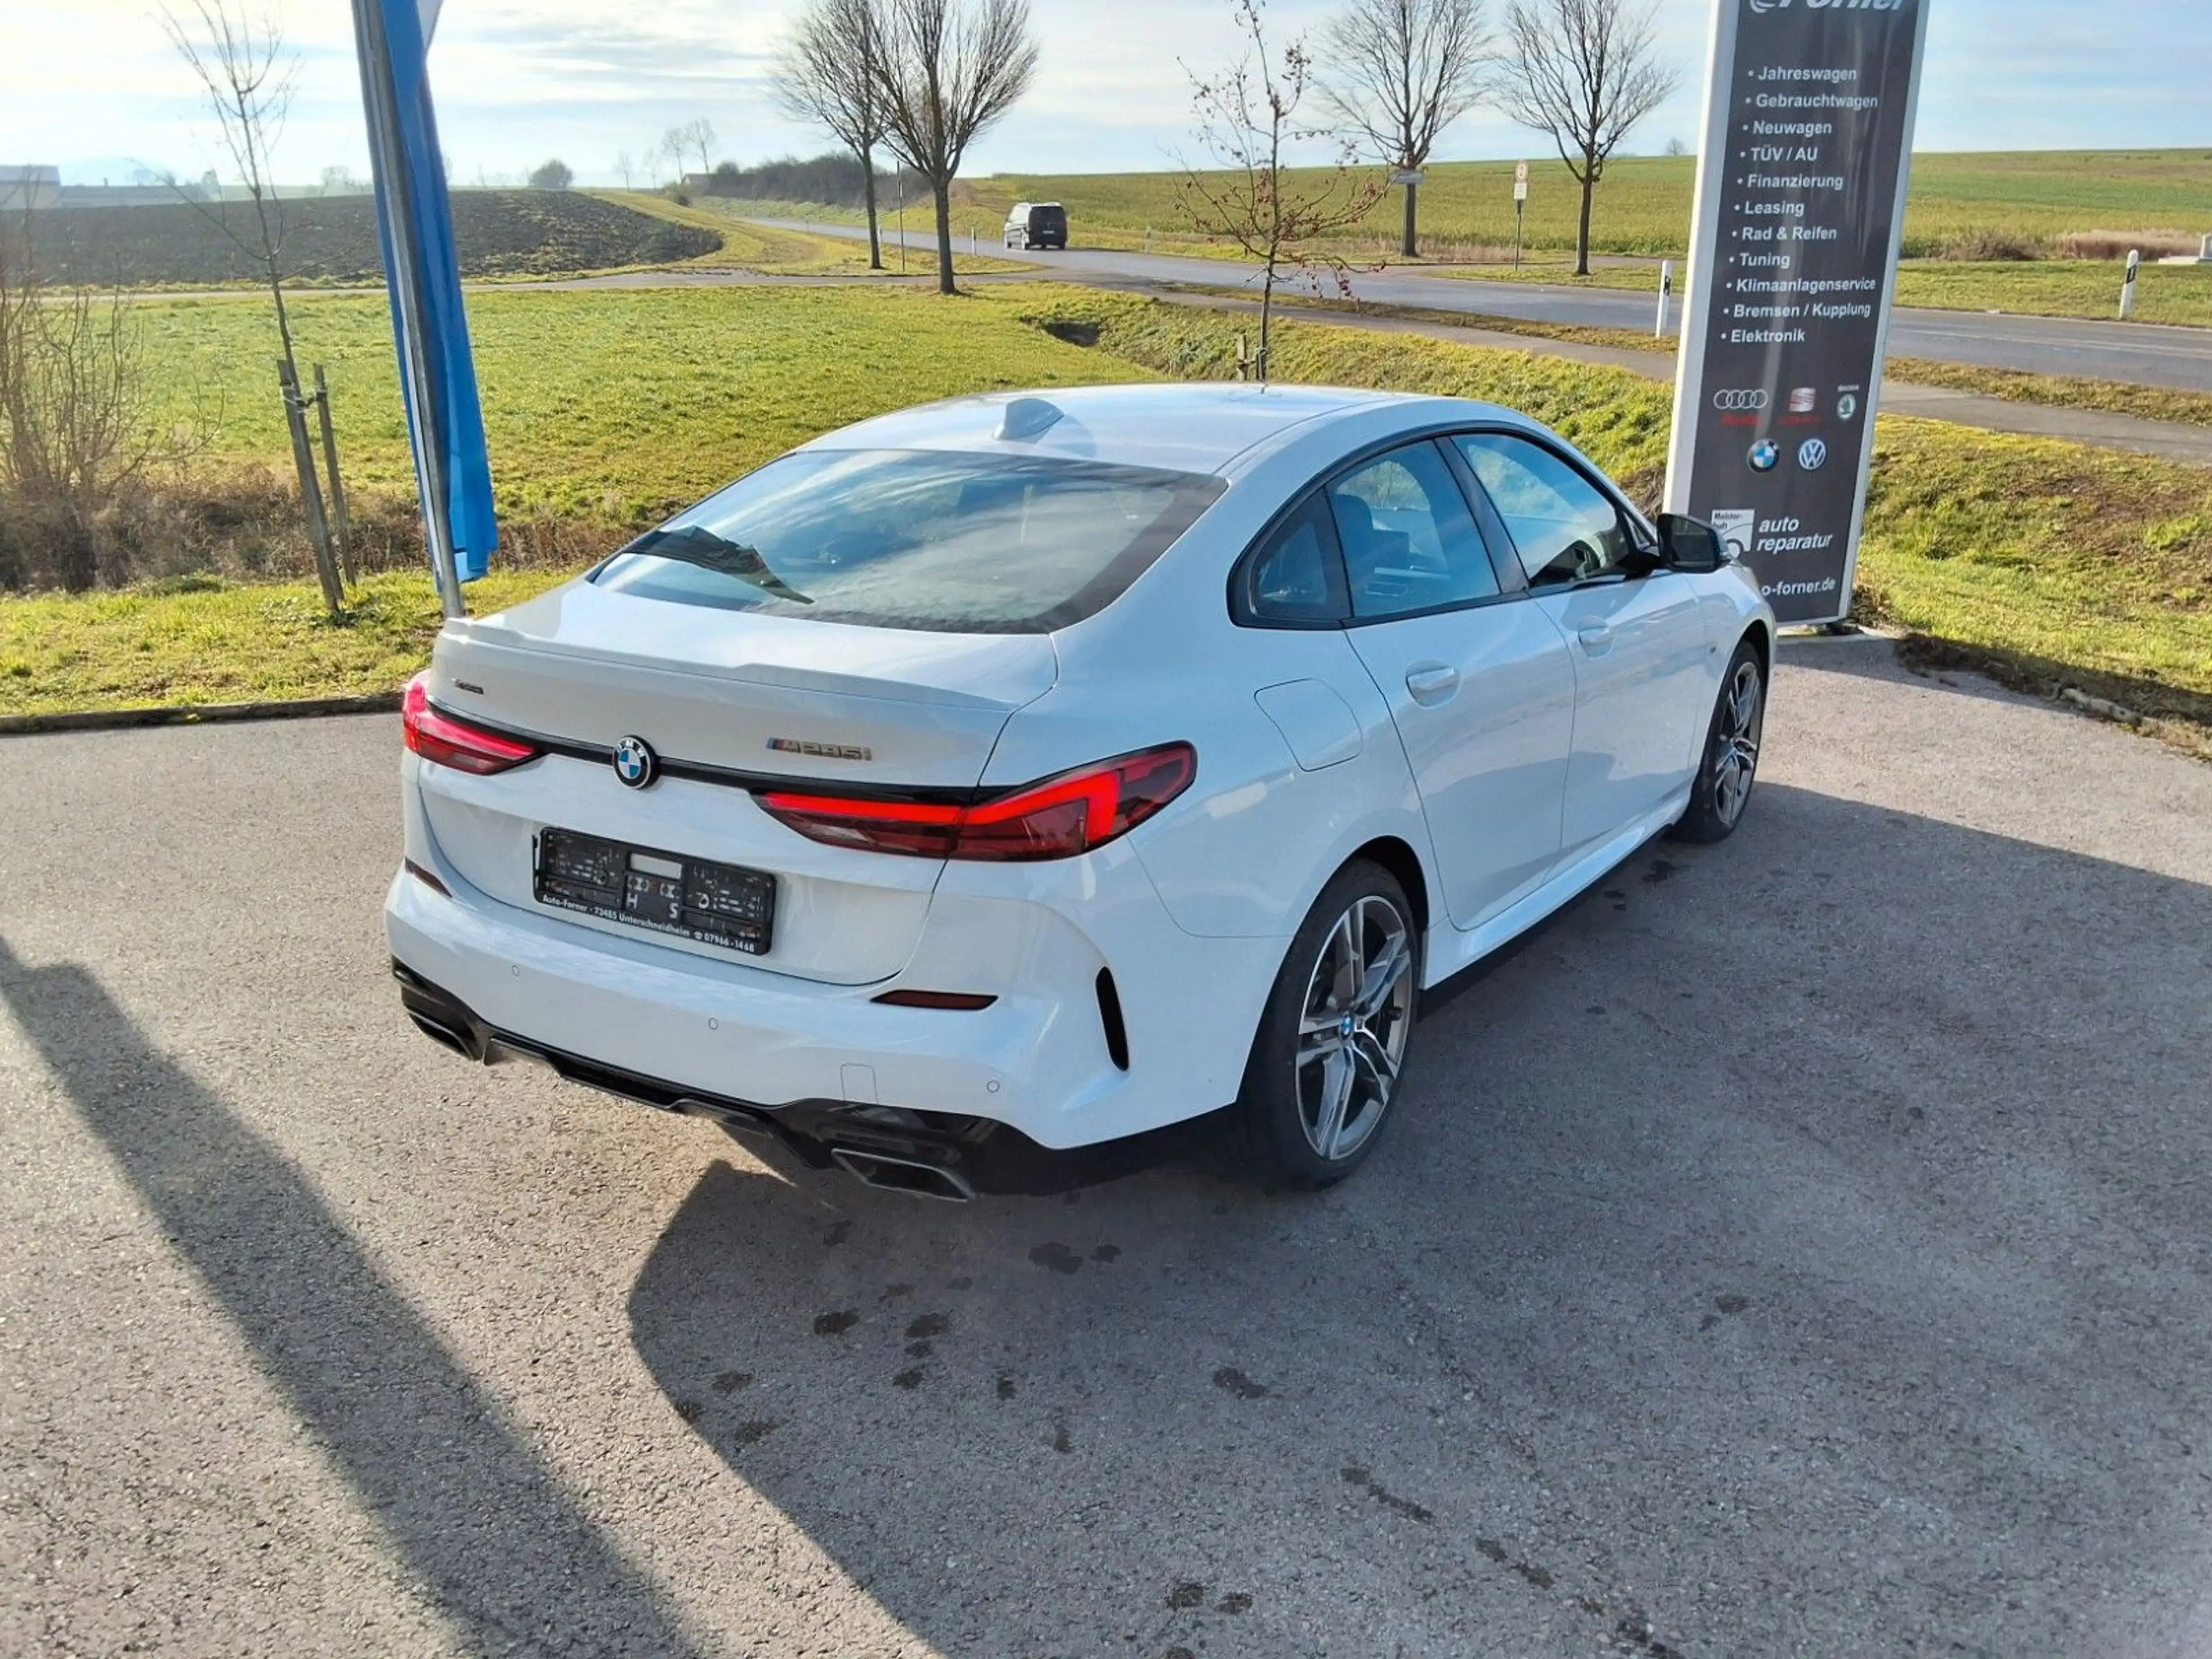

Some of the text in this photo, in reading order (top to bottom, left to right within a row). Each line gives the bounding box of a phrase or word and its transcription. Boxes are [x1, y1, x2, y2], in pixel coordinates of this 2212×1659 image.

[1759, 67, 1857, 82] Jahreswagen
[1756, 93, 1878, 109] Gebrauchtwagen
[1753, 121, 1832, 137] Neuwagen
[1751, 145, 1783, 161] TÜV
[1794, 148, 1818, 161] AU
[1747, 174, 1844, 190] Finanzierung
[1744, 201, 1805, 217] Leasing
[1742, 226, 1837, 241] Rad & Reifen
[1739, 252, 1790, 267] Tuning
[1736, 277, 1876, 294] Klimaanlagenservice
[1734, 304, 1800, 317] Bremsen
[1812, 302, 1871, 319] Kupplung
[1730, 328, 1805, 343] Elektronik
[1759, 516, 1800, 533] auto
[1757, 533, 1833, 555] reparatur
